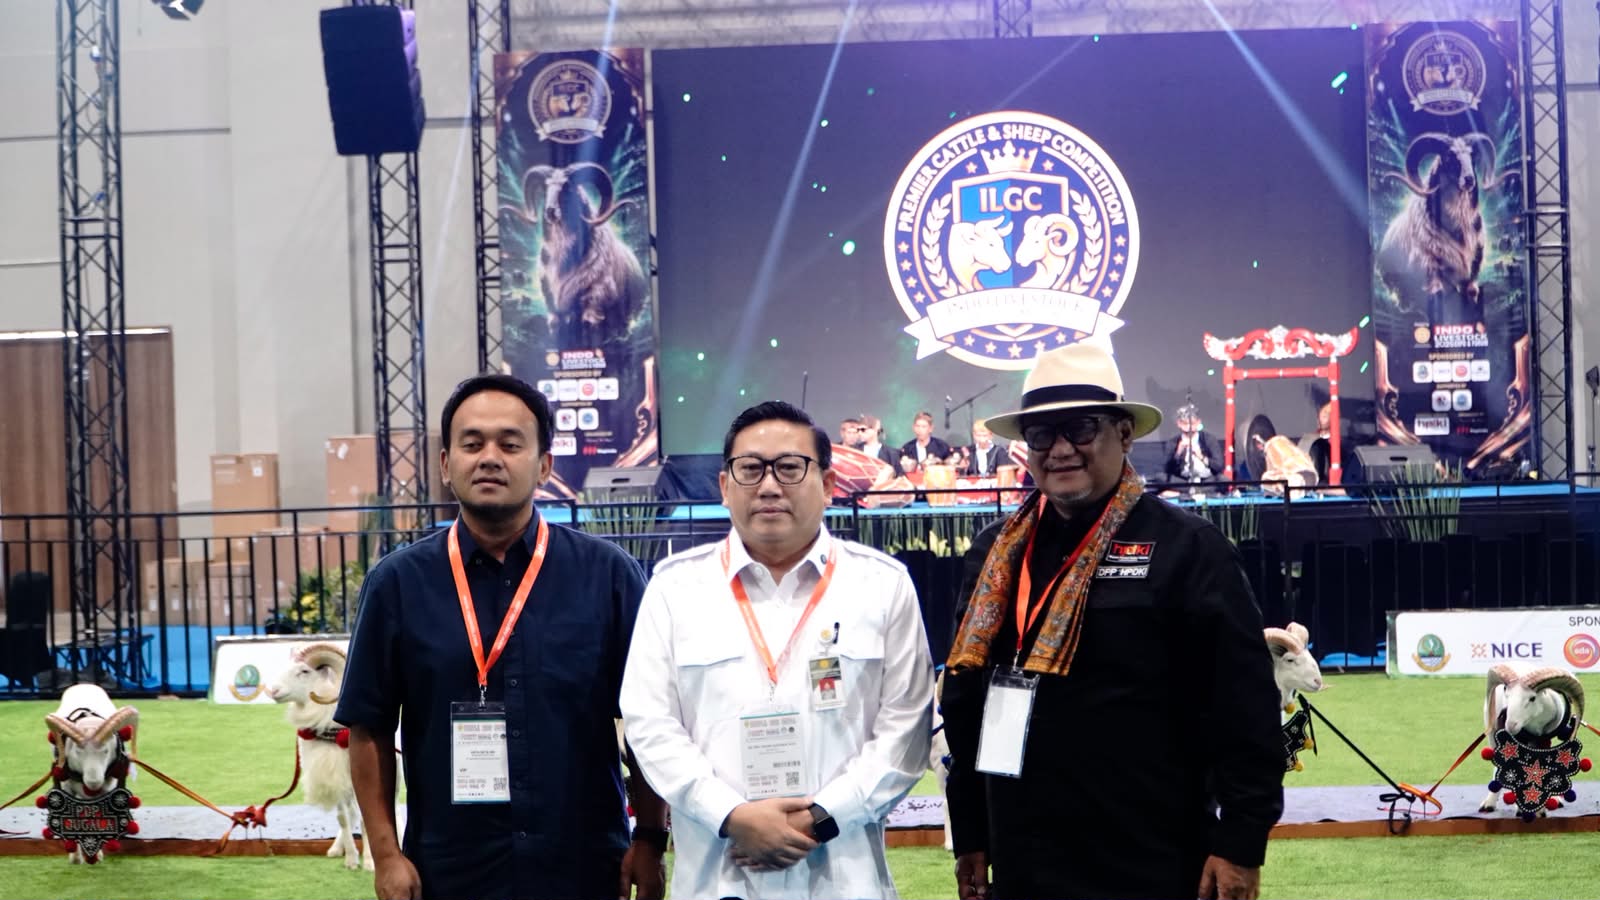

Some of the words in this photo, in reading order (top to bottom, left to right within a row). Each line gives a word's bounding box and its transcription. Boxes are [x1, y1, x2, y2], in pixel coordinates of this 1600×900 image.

[897, 167, 937, 233] PREMIER
[930, 128, 987, 170] CATTLE
[987, 125, 1003, 142] &
[1002, 123, 1053, 145] SHEEP
[1051, 134, 1126, 226] COMPETITION
[979, 186, 1043, 213] ILGC
[1434, 326, 1474, 335] INDO
[1098, 568, 1117, 577] DPP
[1119, 567, 1148, 577] HPDKI
[1568, 616, 1600, 627] SPON
[1491, 642, 1543, 659] NICE
